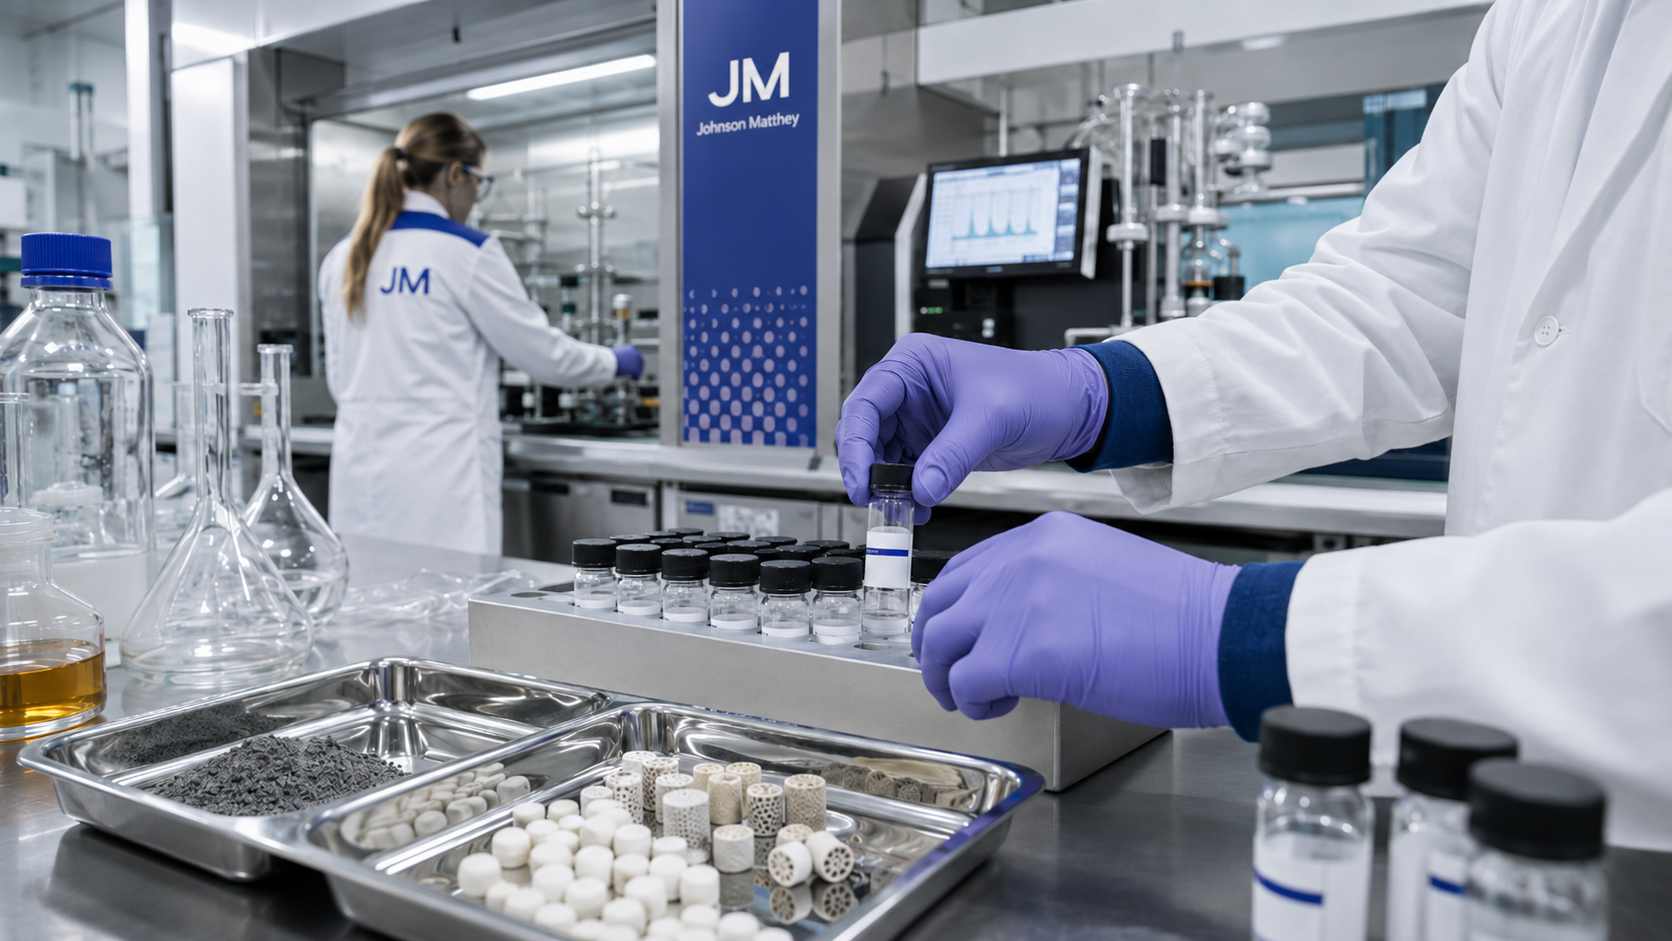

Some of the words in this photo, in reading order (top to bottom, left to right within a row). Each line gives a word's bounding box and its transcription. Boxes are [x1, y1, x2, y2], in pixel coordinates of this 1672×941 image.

[708, 51, 789, 107] JM
[696, 120, 747, 136] Johnson
[748, 112, 800, 128] Matthey
[380, 267, 431, 295] JM
